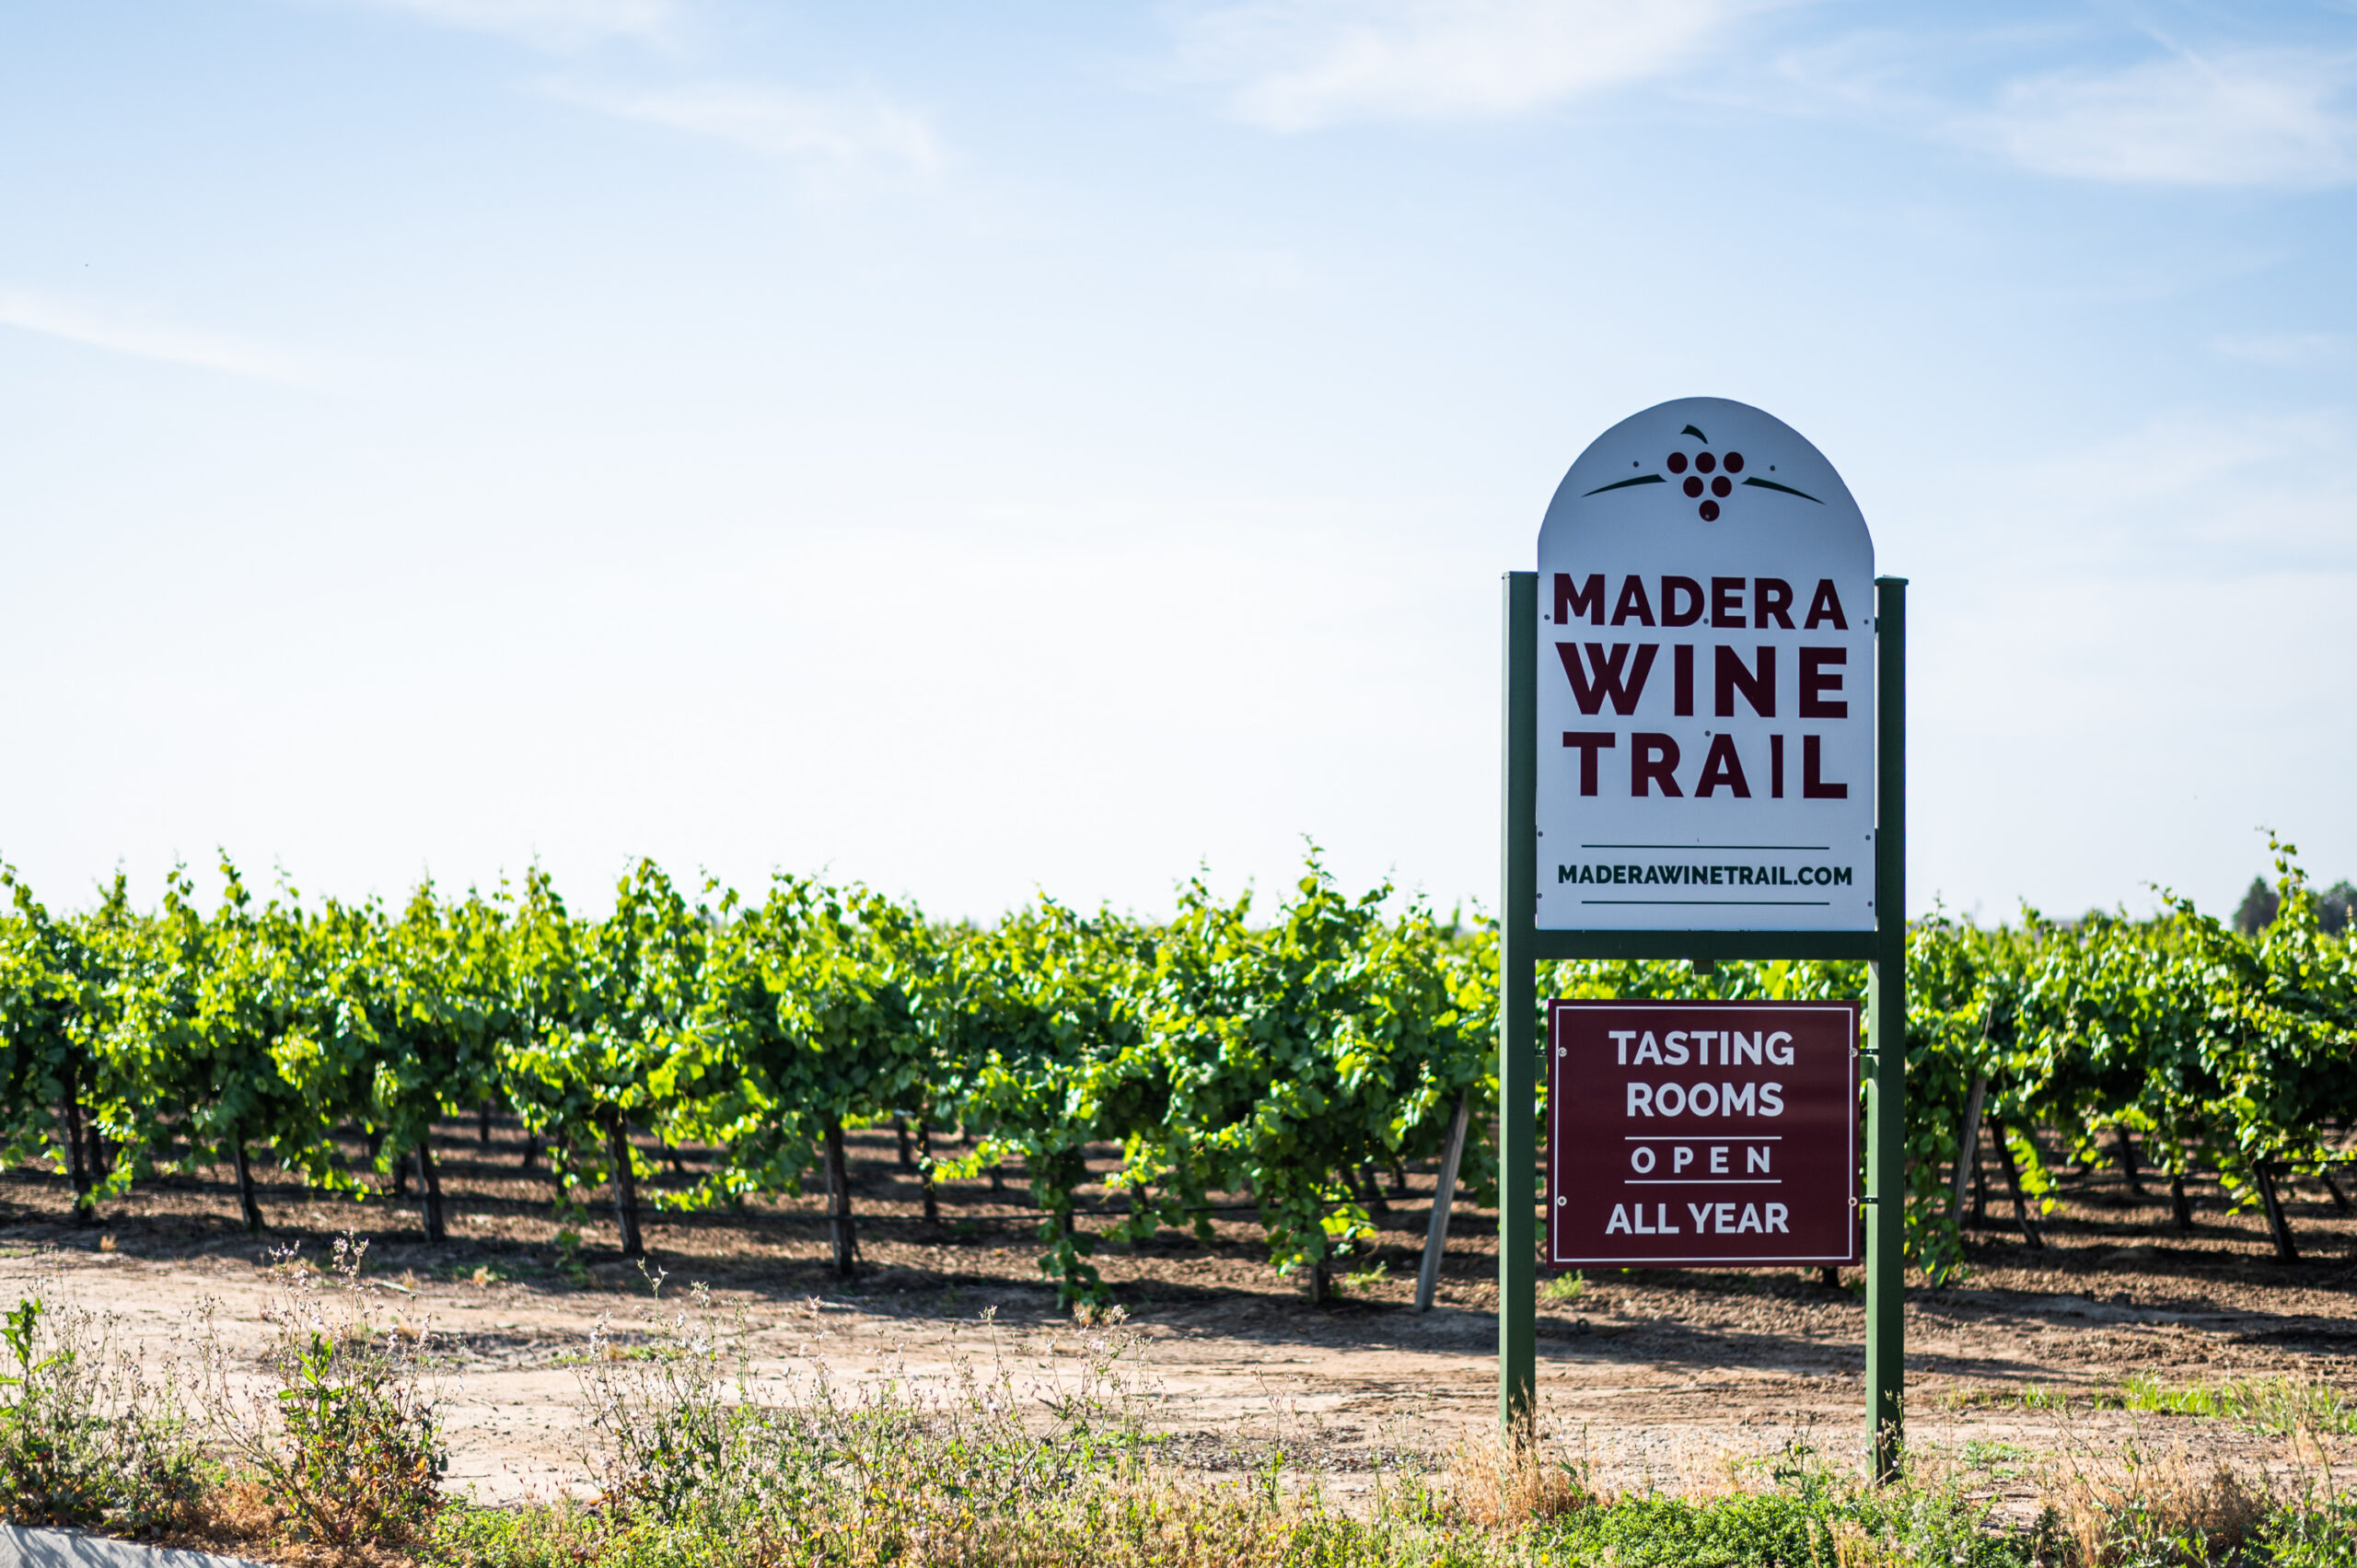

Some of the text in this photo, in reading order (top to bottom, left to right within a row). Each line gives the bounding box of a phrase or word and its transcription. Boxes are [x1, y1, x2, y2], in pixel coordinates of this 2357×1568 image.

[1553, 573, 1849, 630] MADERA
[1554, 642, 1848, 718] WINE
[1562, 731, 1848, 799] TRAIL
[1558, 865, 1852, 886] MADERAWINETRAIL.COM
[1608, 1030, 1794, 1065] TASTING
[1627, 1082, 1784, 1117] ROOMS
[1631, 1146, 1770, 1174] OPEN
[1605, 1202, 1789, 1235] ALL YEAR
